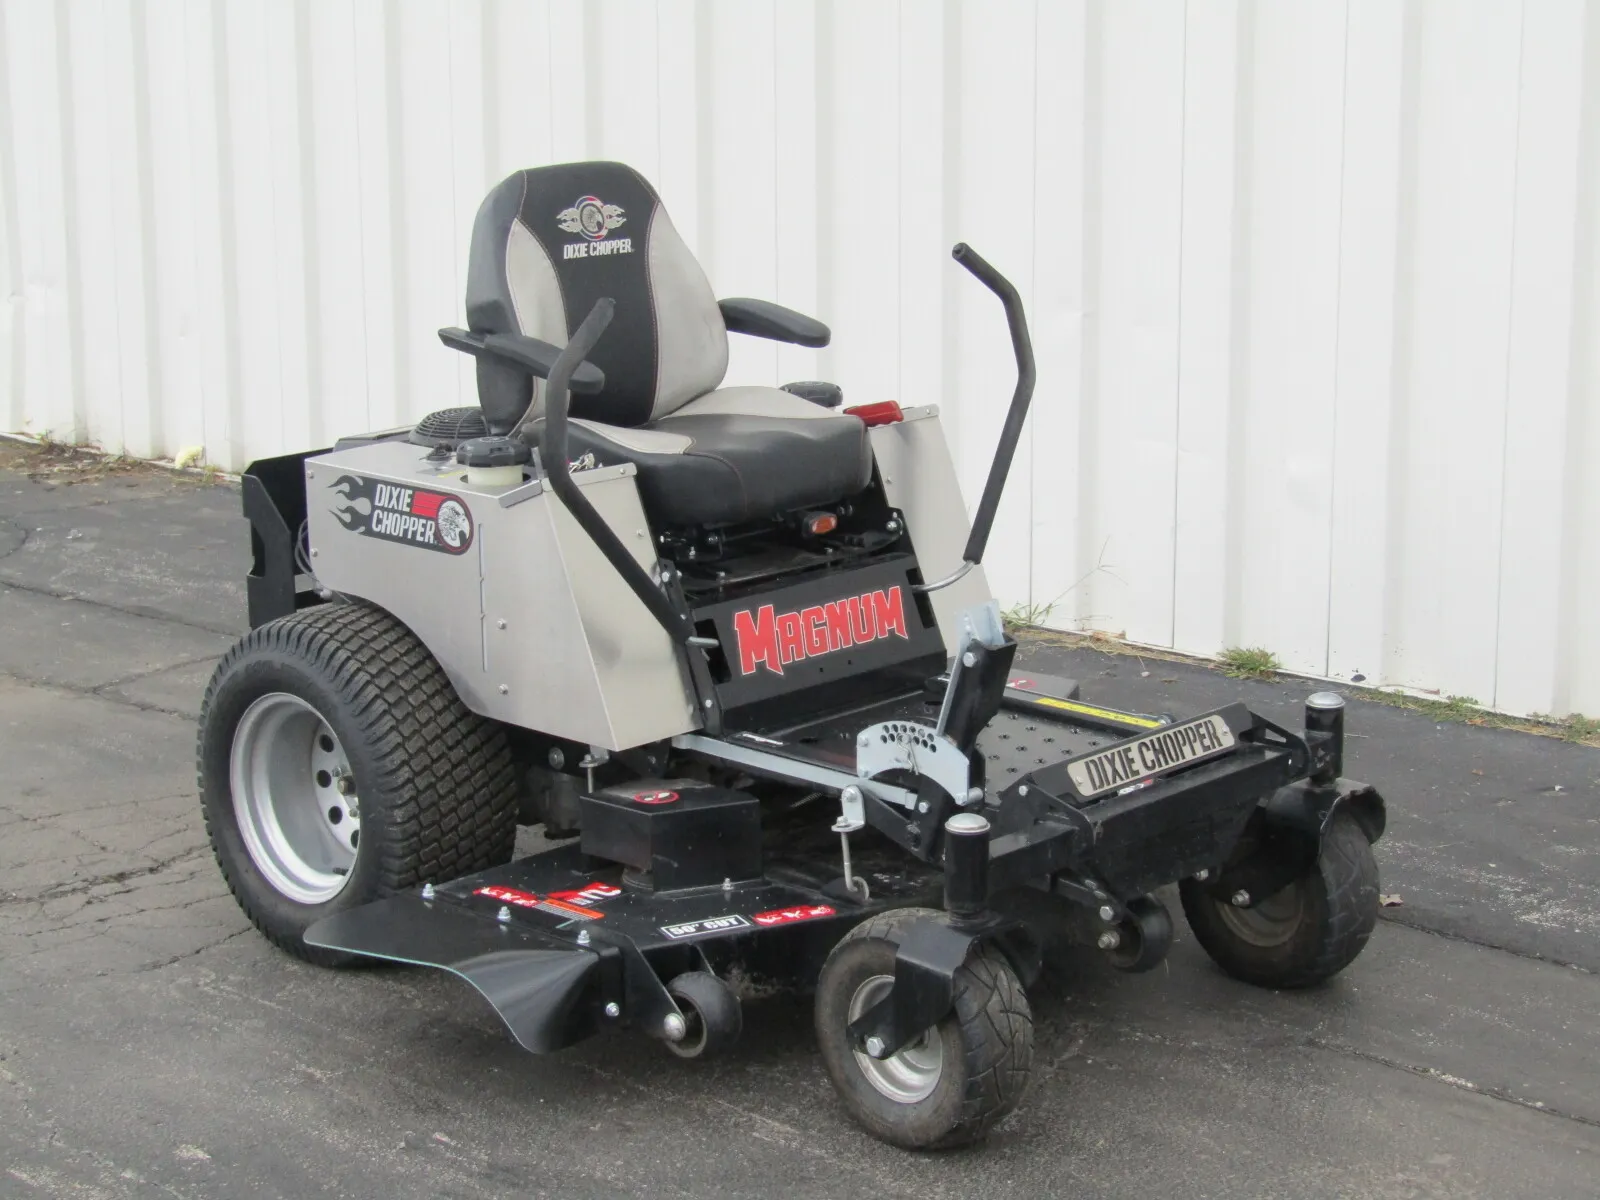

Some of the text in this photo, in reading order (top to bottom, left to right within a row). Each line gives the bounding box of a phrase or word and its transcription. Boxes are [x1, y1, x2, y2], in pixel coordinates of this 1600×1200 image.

[564, 239, 632, 260] DIXIE CHOPPER
[375, 484, 413, 512] DIXIE
[371, 509, 436, 544] CHOPPER
[734, 586, 908, 675] MAGNUM
[1084, 719, 1223, 791] DIXIE CHOPPER
[703, 917, 739, 929] CUT
